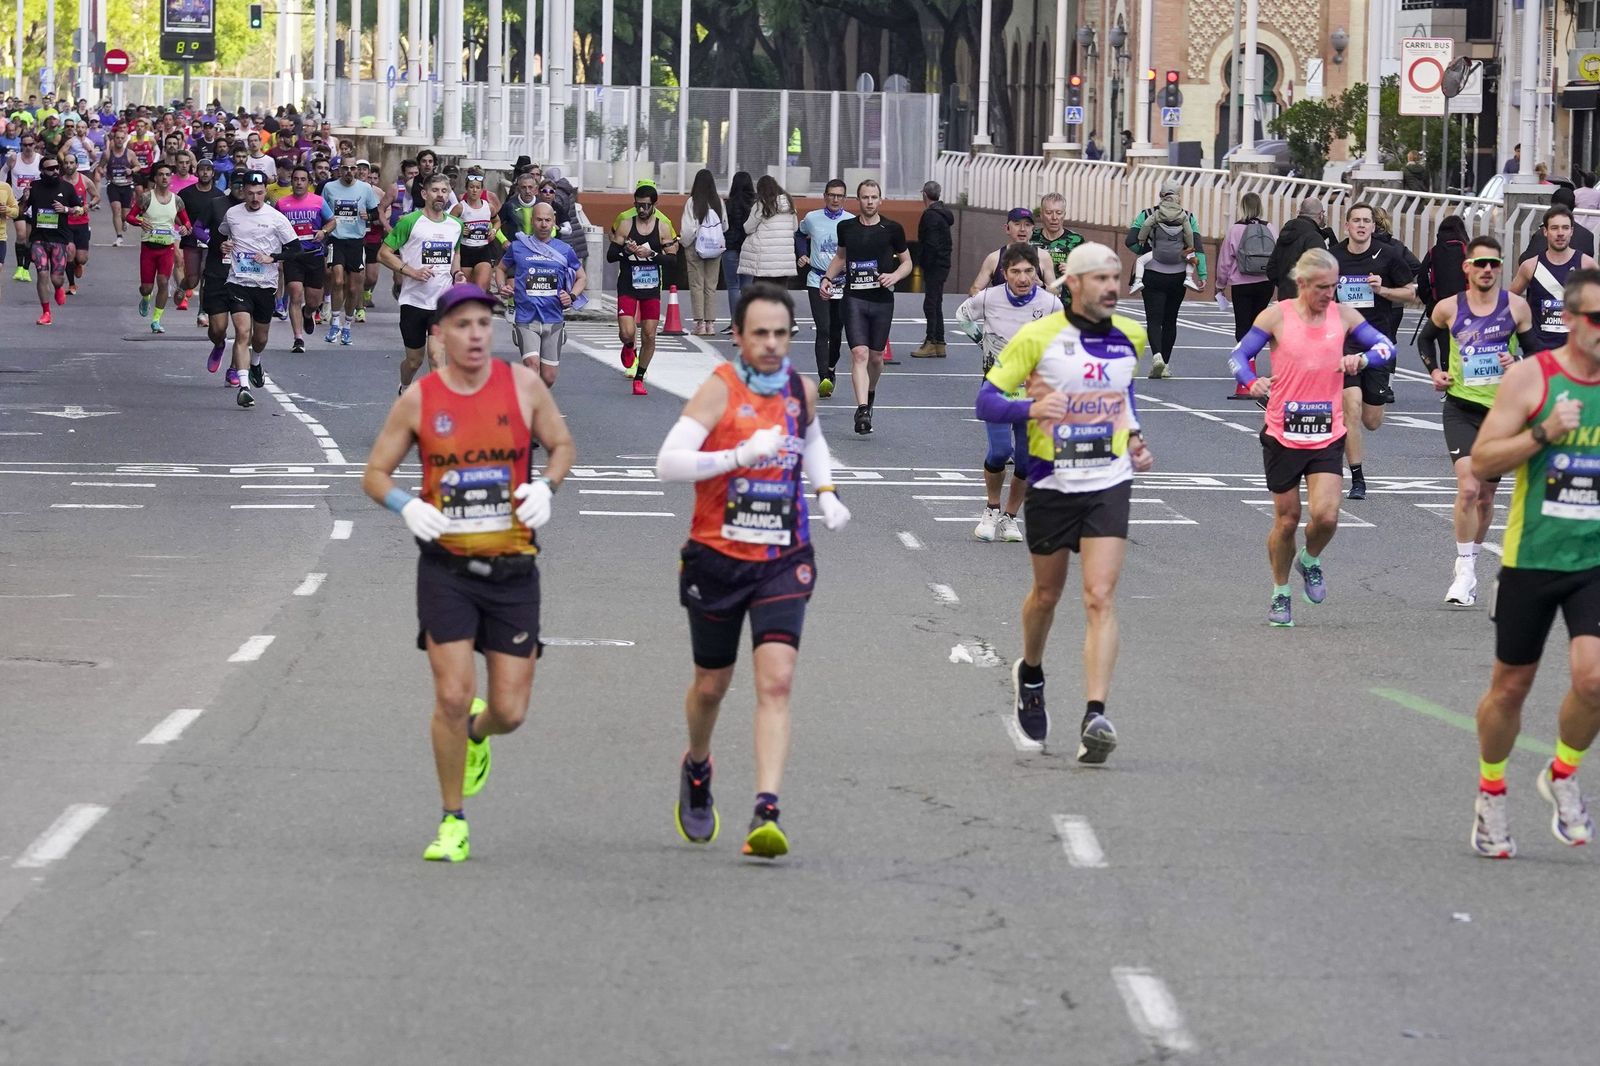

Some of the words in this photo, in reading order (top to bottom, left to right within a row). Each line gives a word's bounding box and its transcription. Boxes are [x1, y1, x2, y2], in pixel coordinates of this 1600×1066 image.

[1405, 41, 1432, 49] CARRIL
[1474, 366, 1499, 376] KEVIN
[1074, 426, 1107, 435] ZURICH
[1289, 424, 1327, 433] VIRUS
[462, 469, 504, 482] ZURICH
[753, 482, 788, 494] ZURICH
[732, 512, 783, 529] JUANCA
